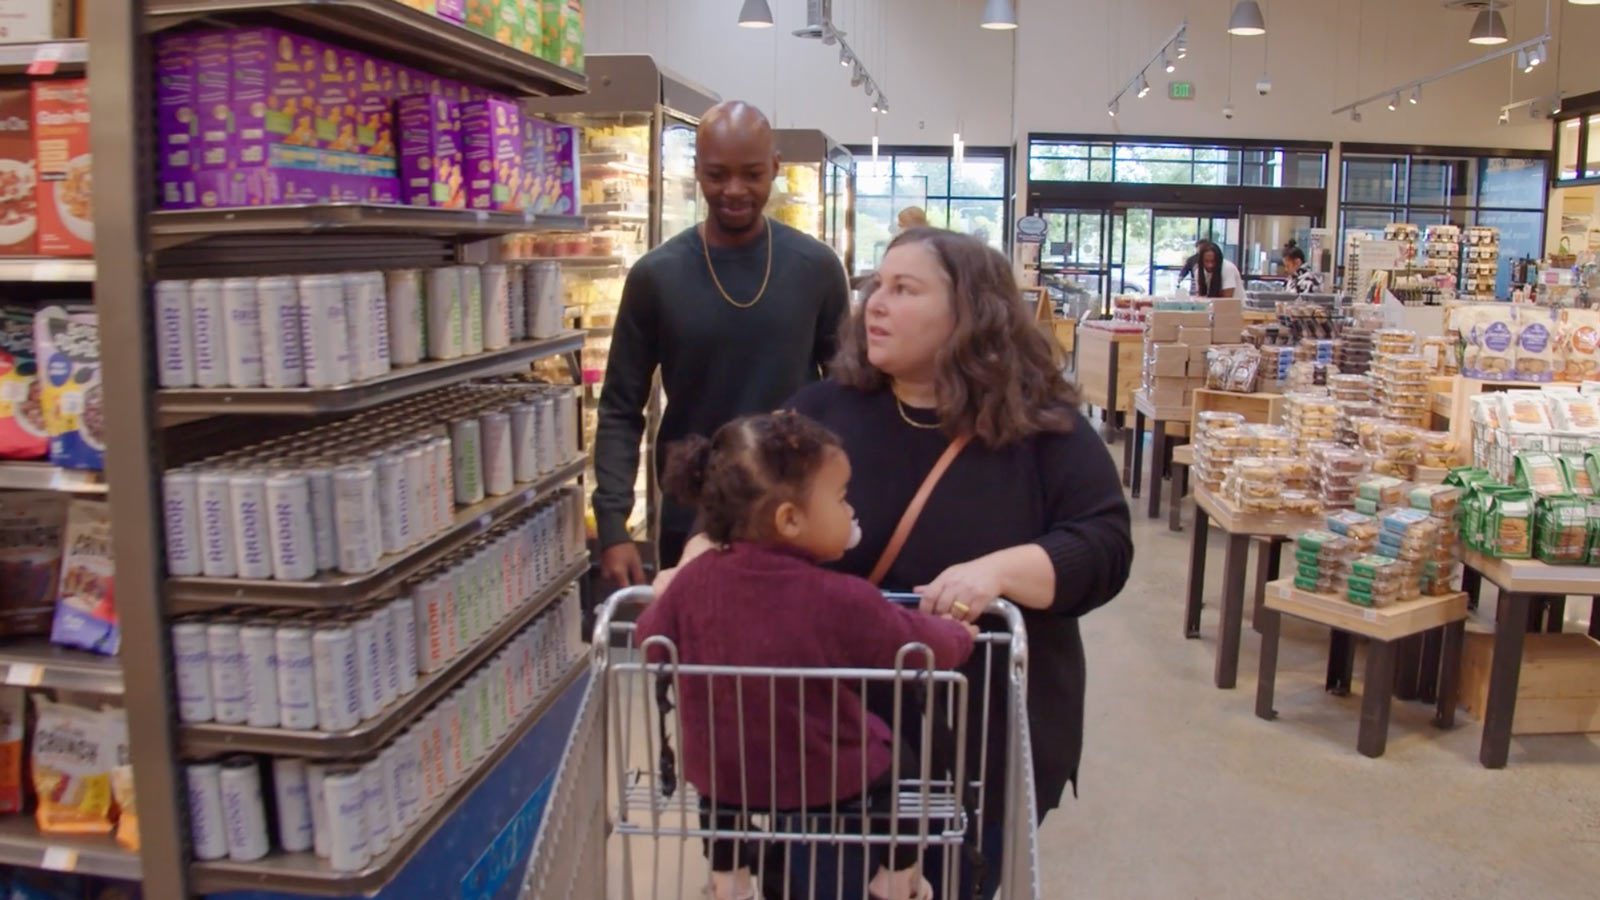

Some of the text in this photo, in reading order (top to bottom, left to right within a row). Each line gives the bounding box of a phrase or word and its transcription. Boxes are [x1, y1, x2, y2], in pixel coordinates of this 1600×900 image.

[1173, 83, 1190, 97] EXIT
[205, 500, 223, 562] ARDOR
[241, 501, 261, 564] ARDOR
[276, 503, 296, 566] ARDOR
